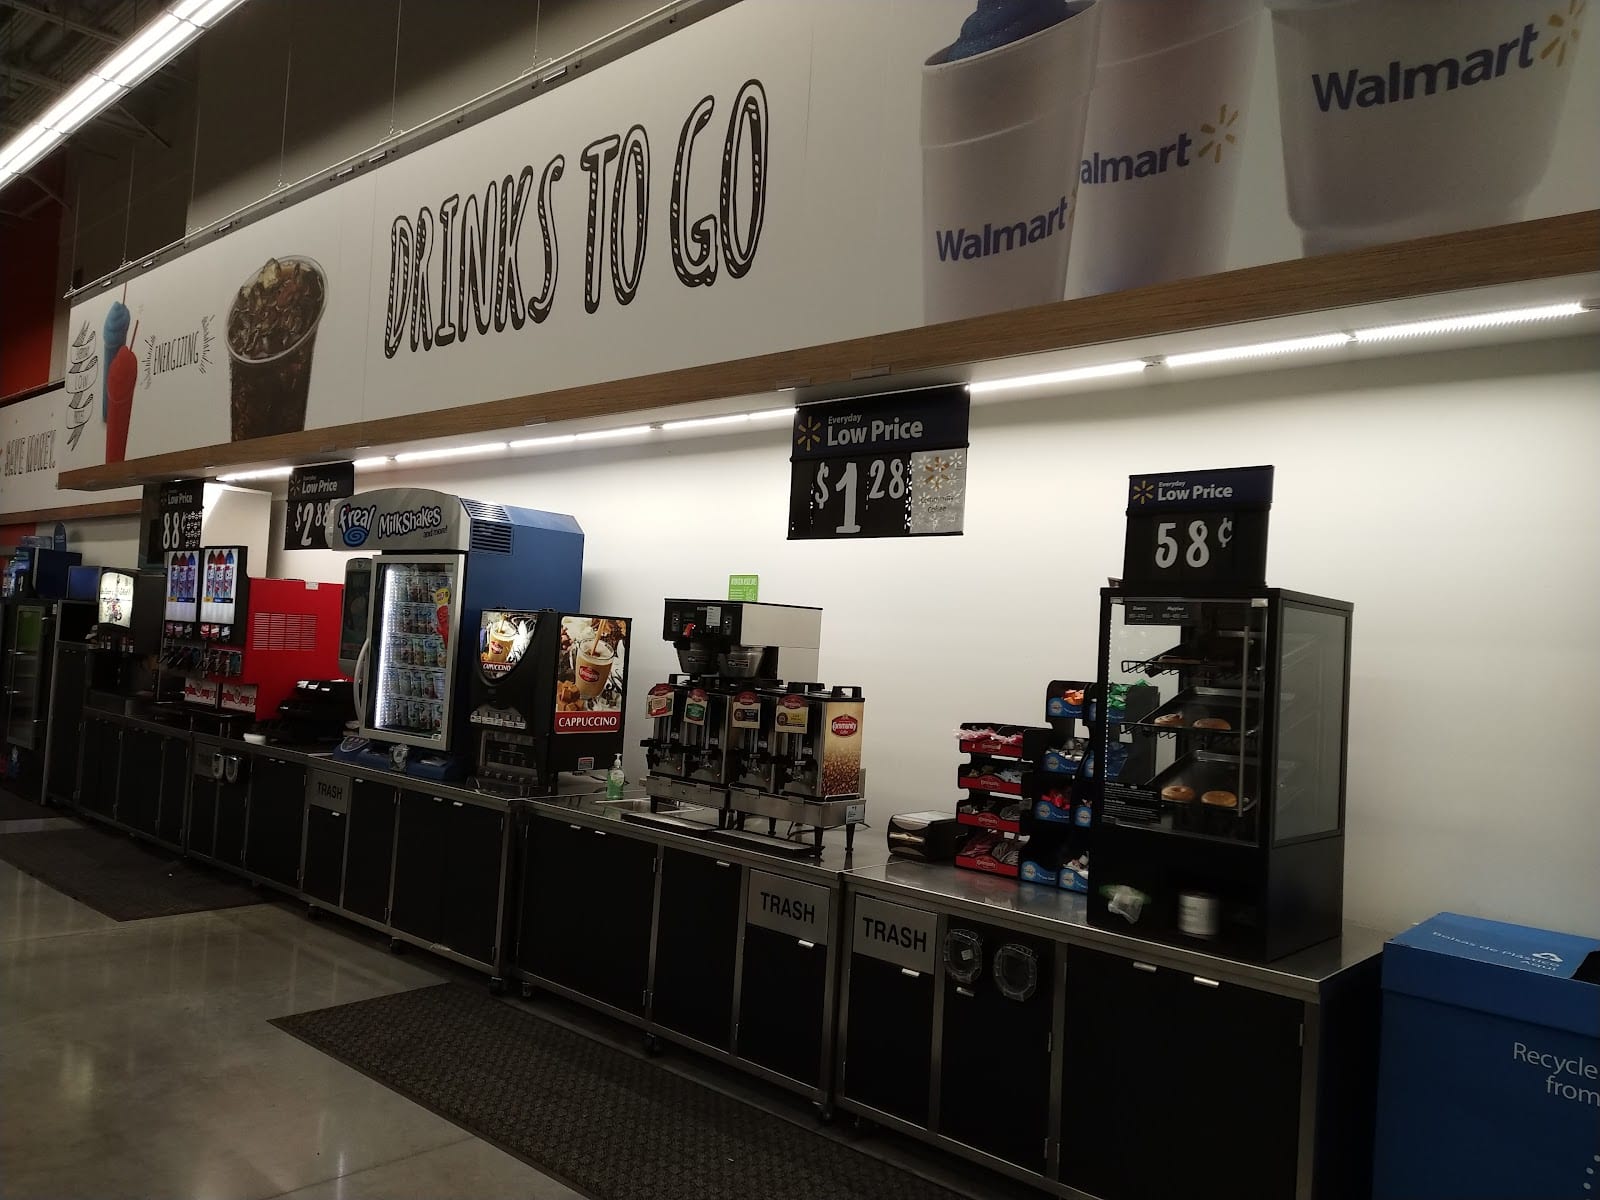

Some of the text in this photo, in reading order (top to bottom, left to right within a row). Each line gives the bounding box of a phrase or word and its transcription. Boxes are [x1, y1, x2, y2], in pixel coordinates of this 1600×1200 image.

[1311, 22, 1541, 112] Walmart
[385, 78, 768, 359] DRINKS TO GO
[936, 195, 1067, 262] Walmart
[153, 330, 200, 375] ENERGIZING
[827, 417, 923, 446] Low Price
[828, 412, 862, 424] Everyday
[302, 478, 338, 494] Low Price
[1158, 480, 1186, 488] Everyday
[1158, 484, 1233, 501] Low Price
[558, 716, 617, 728] CAPPUCCINO
[317, 782, 343, 801] TRASH
[760, 891, 815, 925] TRASH
[862, 916, 927, 952] TRASH
[1513, 1041, 1599, 1080] Recycle
[1545, 1075, 1600, 1107] from
